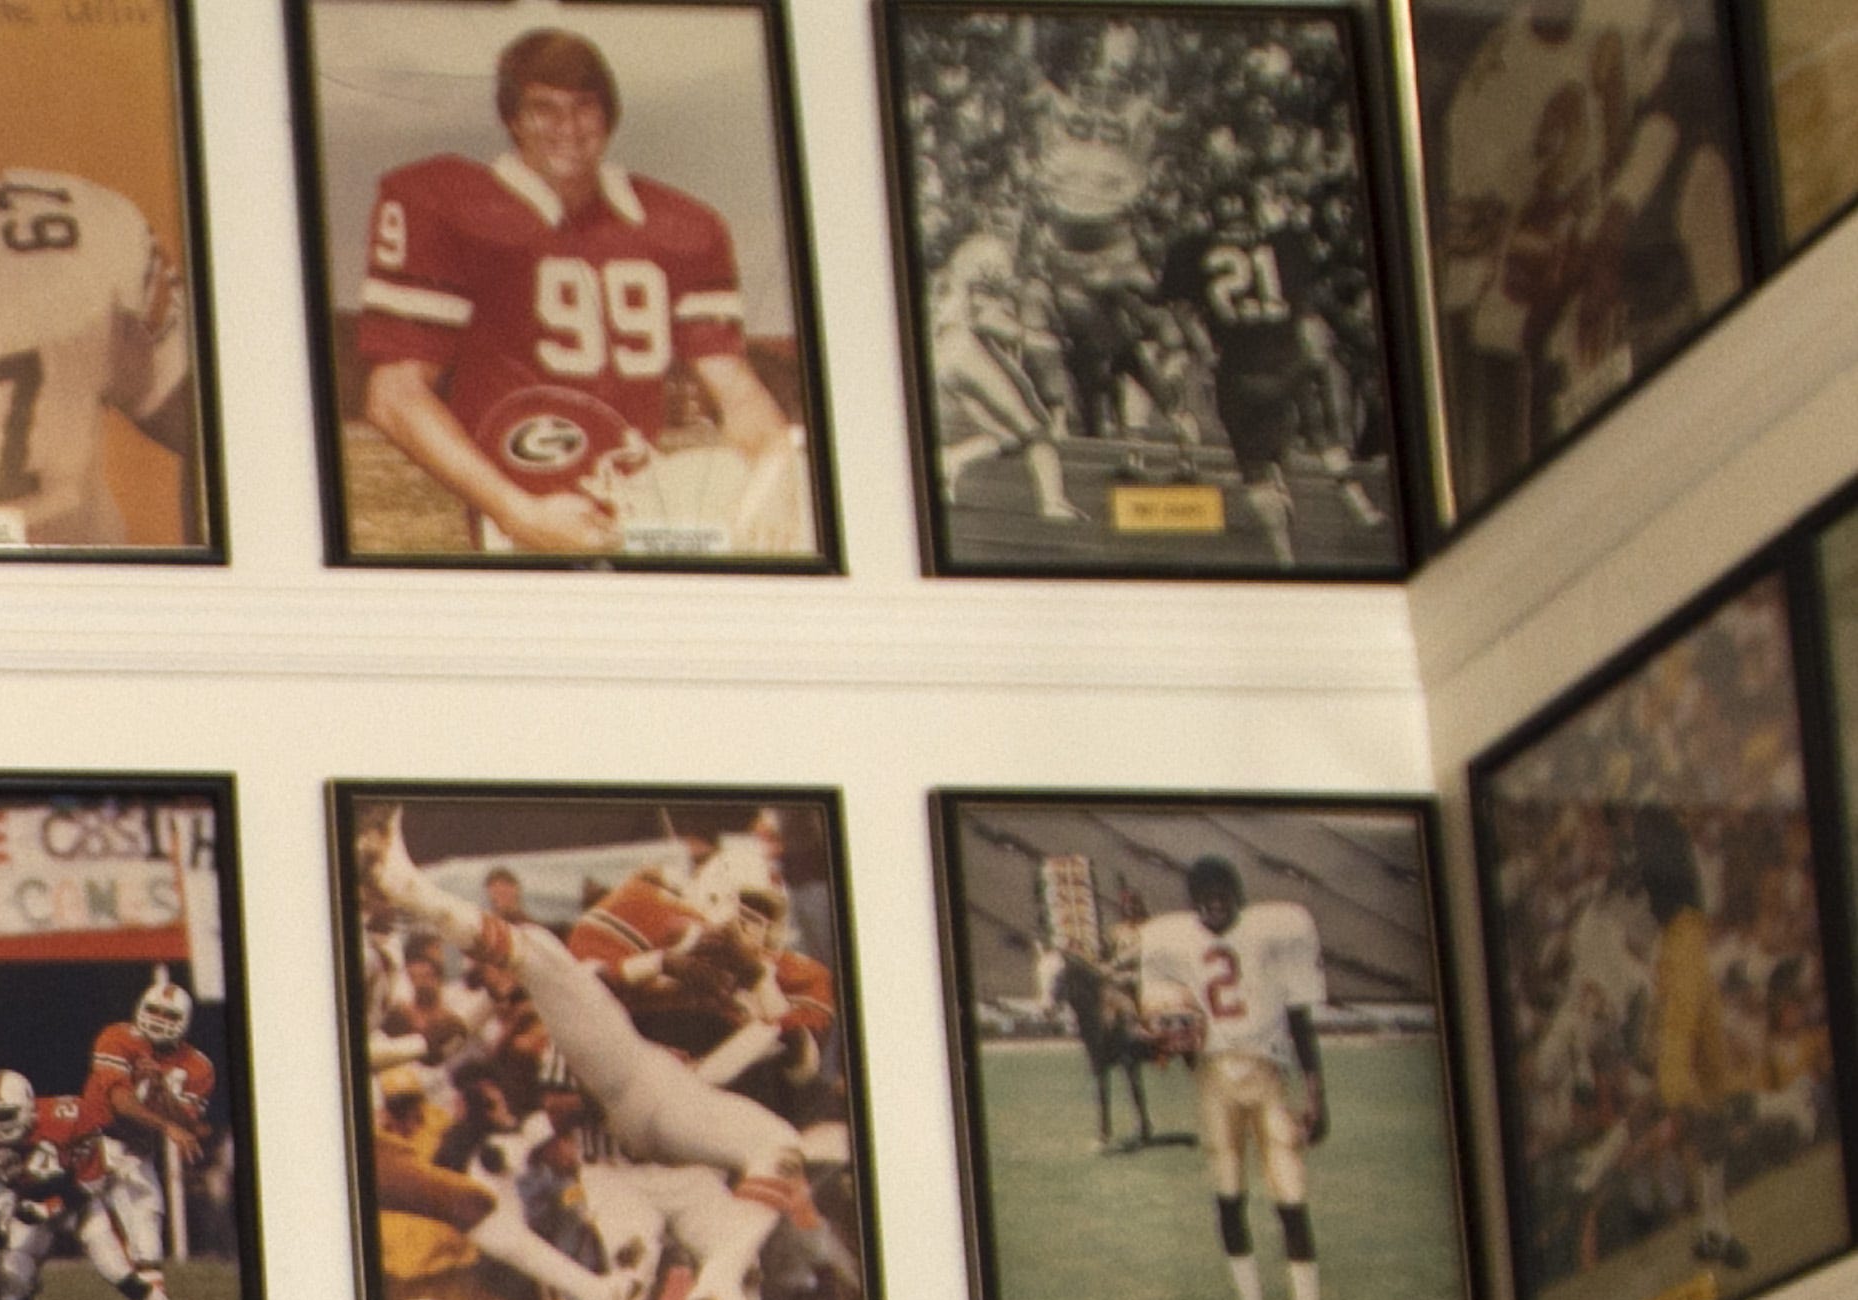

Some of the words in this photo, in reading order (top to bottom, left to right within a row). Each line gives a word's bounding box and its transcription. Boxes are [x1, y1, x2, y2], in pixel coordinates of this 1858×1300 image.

[534, 257, 673, 379] 99
[1204, 243, 1290, 321] 21
[1203, 946, 1246, 1019] 2
